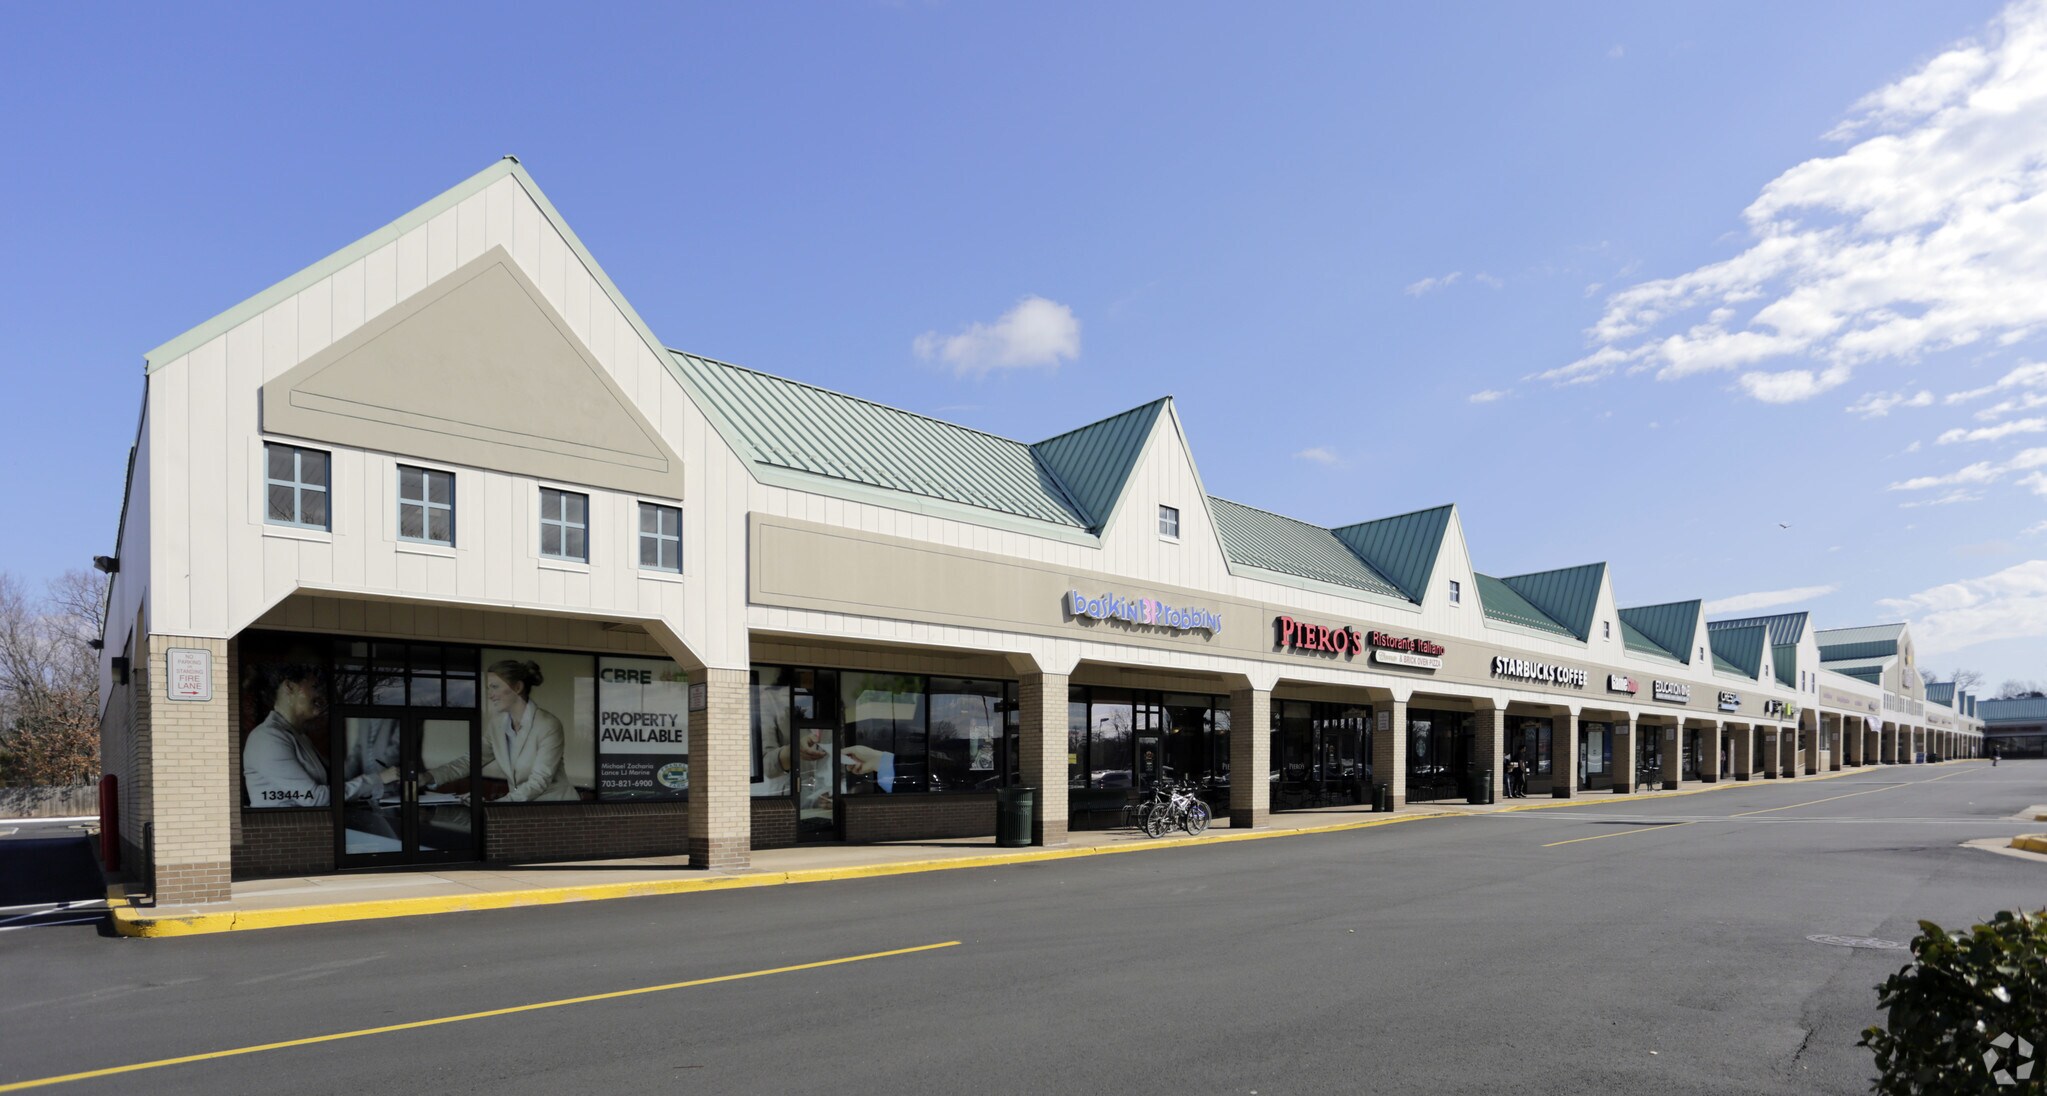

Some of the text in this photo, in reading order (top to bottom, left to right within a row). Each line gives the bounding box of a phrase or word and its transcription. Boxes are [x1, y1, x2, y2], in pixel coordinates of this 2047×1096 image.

[1071, 588, 1138, 624] baskin
[1164, 605, 1222, 635] robbins
[1281, 616, 1362, 655] PIERO'S
[1373, 631, 1415, 651] Ristorante
[1417, 639, 1446, 656] Italiano
[600, 668, 652, 684] CBRE
[1496, 656, 1588, 686] STARBUCKS COFFEE
[601, 711, 678, 727] PROPERTY
[601, 728, 682, 743] AVAILABLE
[261, 790, 314, 800] 13344-A
